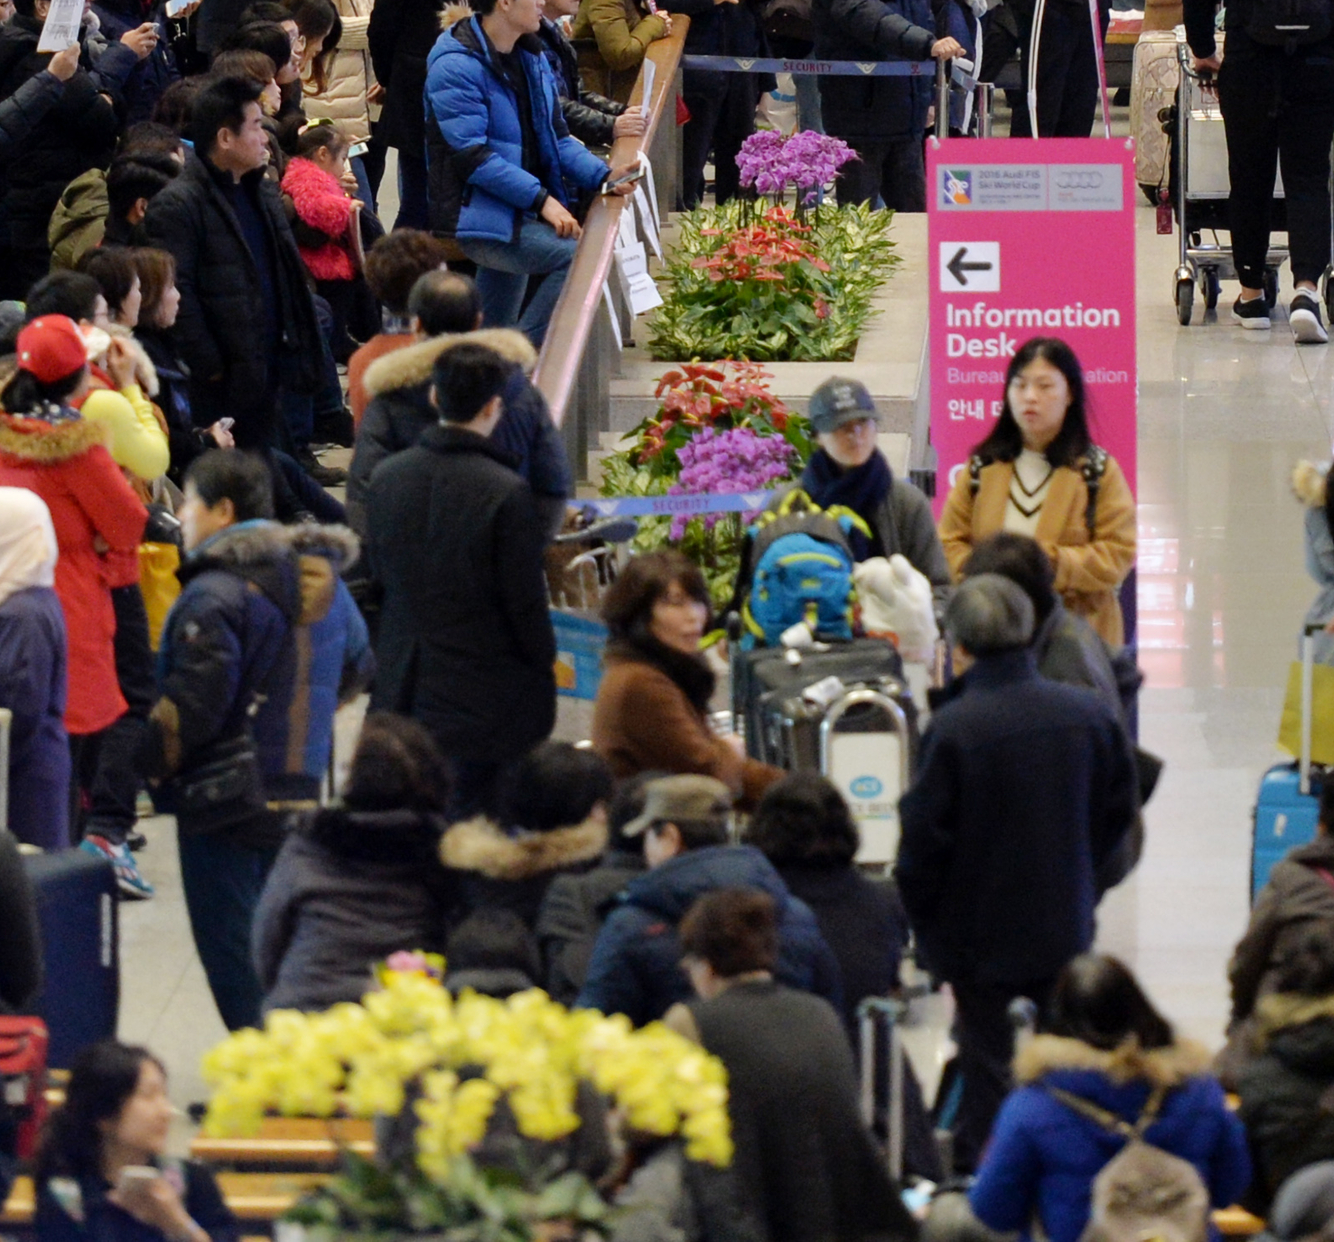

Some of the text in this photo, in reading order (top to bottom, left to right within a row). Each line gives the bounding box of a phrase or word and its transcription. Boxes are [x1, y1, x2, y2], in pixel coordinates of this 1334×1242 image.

[783, 61, 834, 73] SECURITY
[946, 302, 1121, 328] Information
[946, 334, 1017, 358] Desk
[948, 399, 985, 421] 안내
